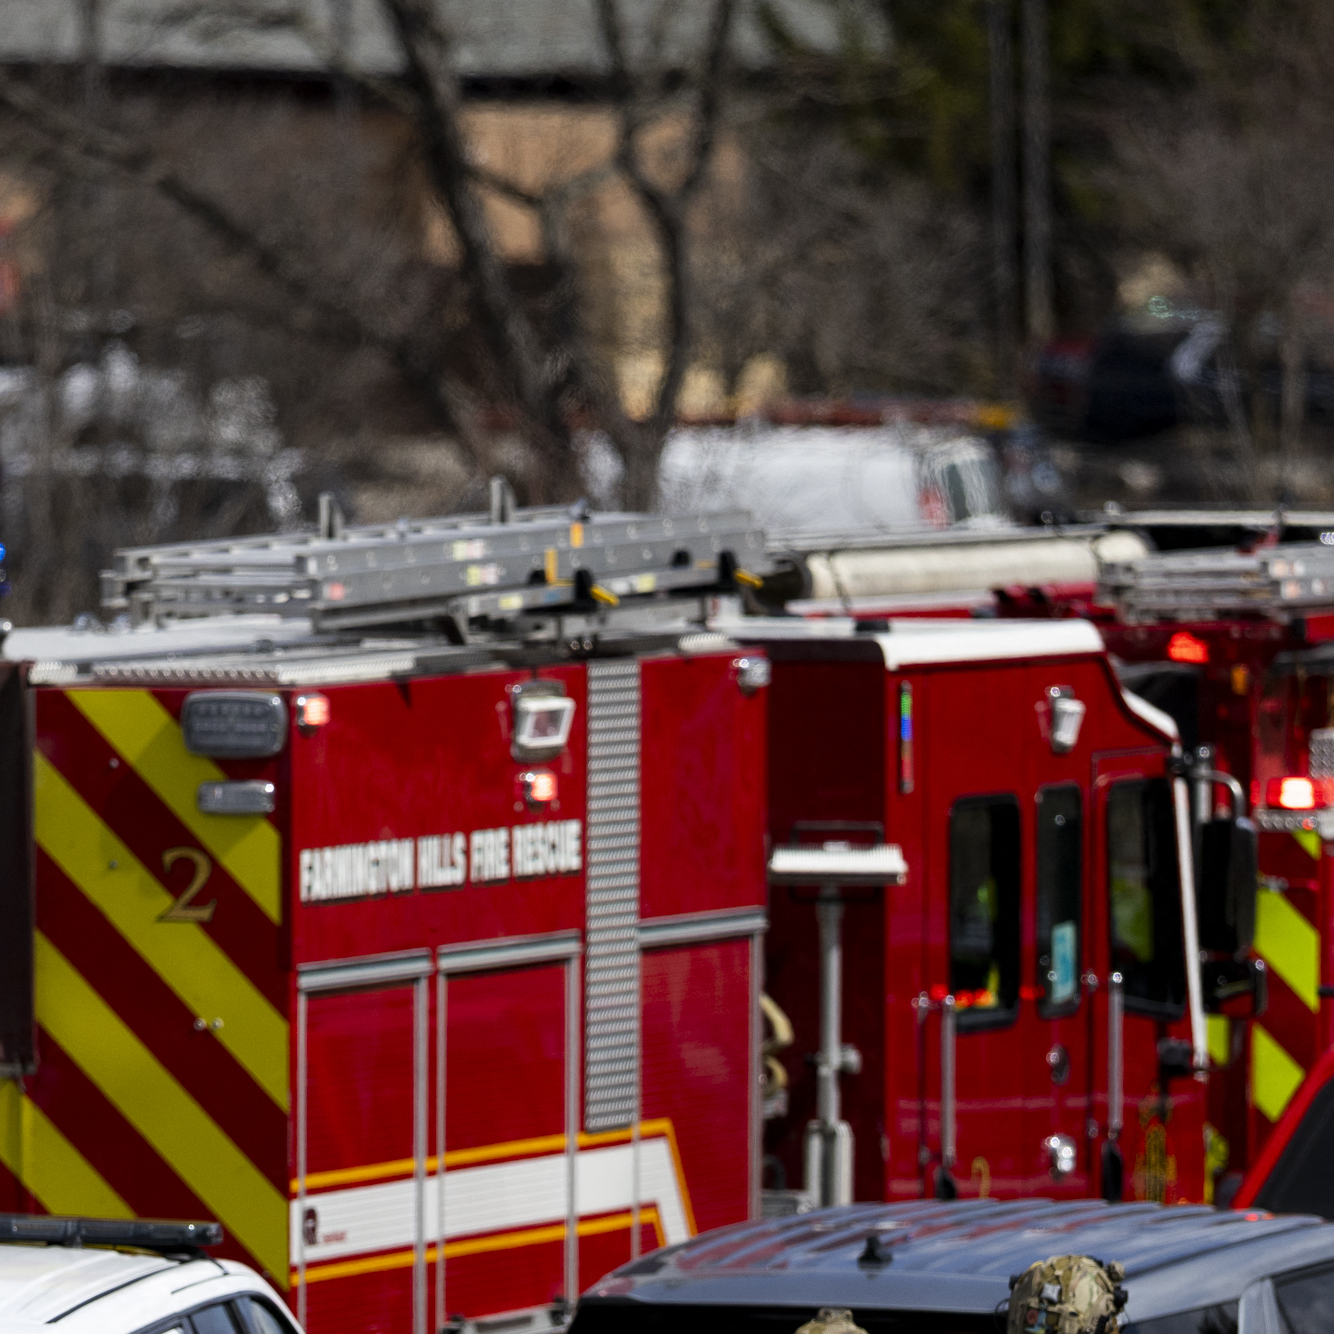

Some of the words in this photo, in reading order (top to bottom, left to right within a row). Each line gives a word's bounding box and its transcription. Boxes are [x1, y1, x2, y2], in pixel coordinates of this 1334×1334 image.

[155, 846, 217, 924] 2
[299, 836, 416, 905] FARMINGTON
[417, 831, 467, 891] HILLS
[469, 826, 511, 885] FIRE
[511, 818, 583, 878] RESCUE
